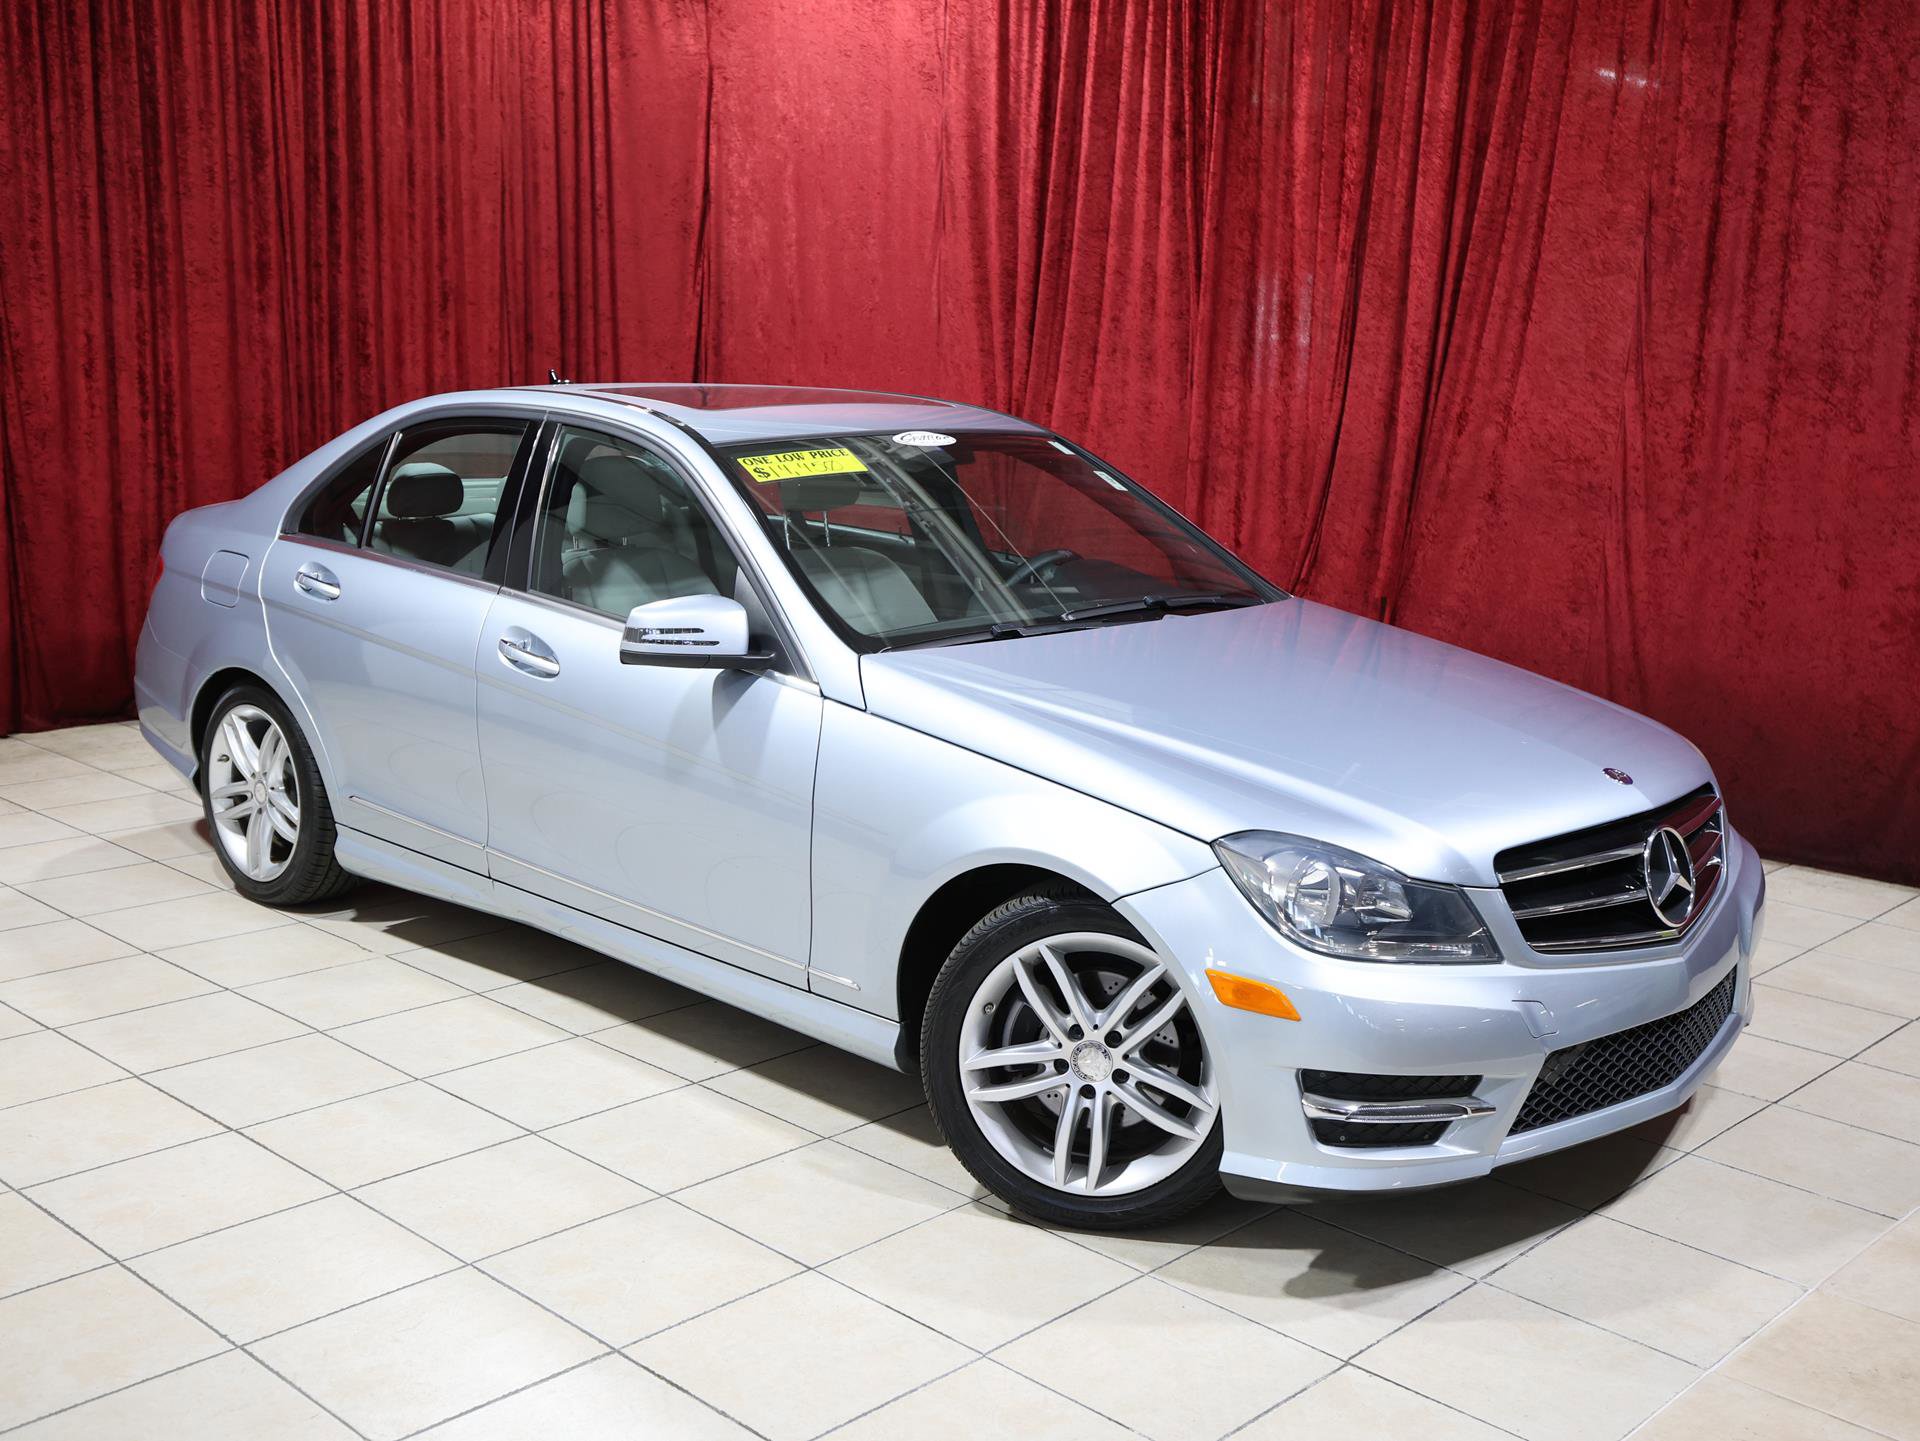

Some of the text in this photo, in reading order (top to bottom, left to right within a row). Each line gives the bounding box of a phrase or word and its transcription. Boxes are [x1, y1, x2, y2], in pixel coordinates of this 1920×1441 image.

[742, 448, 849, 466] ONE LOW PRICE
